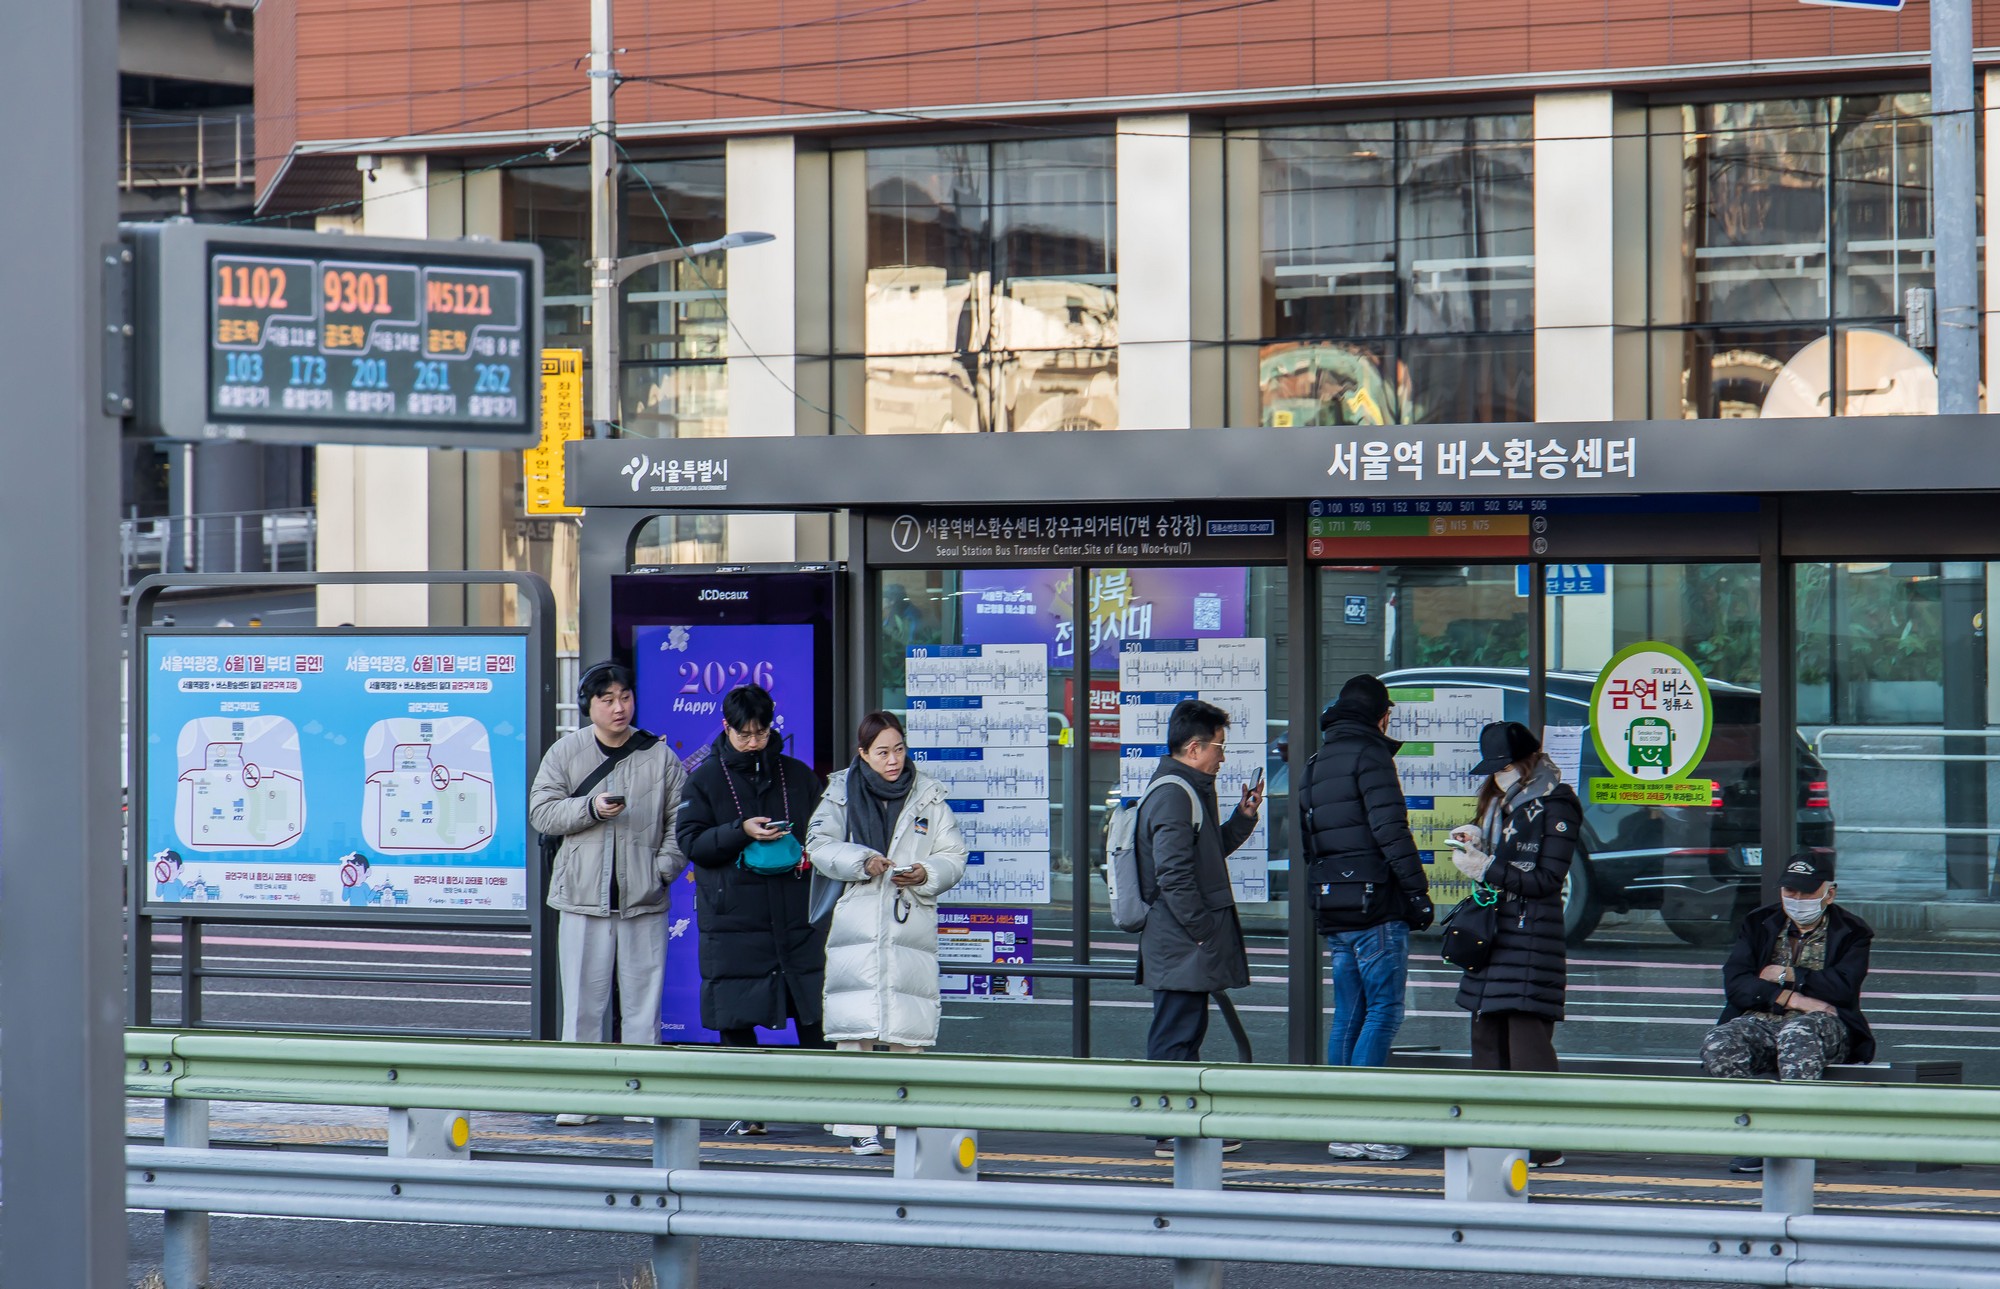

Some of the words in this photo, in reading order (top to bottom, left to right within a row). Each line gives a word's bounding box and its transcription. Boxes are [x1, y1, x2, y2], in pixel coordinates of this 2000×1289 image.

[218, 266, 288, 309] 1102
[324, 270, 392, 314] 9301
[225, 352, 263, 383] 103
[289, 355, 327, 385] 173
[352, 358, 389, 389] 201
[413, 360, 450, 391] 261
[474, 363, 511, 393] 262
[1326, 440, 1423, 481] 서울역
[1437, 437, 1636, 480] 버스환승센터
[650, 459, 728, 483] 서울특별시
[1327, 502, 1342, 513] 100
[1350, 502, 1364, 512] 150
[1372, 502, 1386, 512] 151
[1393, 502, 1408, 512] 152
[1415, 501, 1430, 512] 162
[1437, 501, 1452, 512] 500
[1460, 501, 1475, 511] 501
[1484, 501, 1500, 511] 502
[1507, 500, 1523, 511] 504
[1531, 500, 1547, 510] 506
[1156, 514, 1201, 537] 승강장)
[1328, 521, 1345, 531] 1711
[1353, 520, 1371, 531] 7016
[1451, 520, 1467, 531] N15
[1473, 520, 1489, 530] N75
[936, 546, 959, 556] Seoul
[962, 545, 993, 556] Station
[996, 545, 1011, 555] Bus
[1014, 544, 1050, 555] Transfer
[1104, 543, 1114, 554] of
[1117, 543, 1138, 556] Kang
[1141, 542, 1191, 556] Woo-kyu(7)
[1546, 581, 1593, 593] 단보도
[698, 589, 749, 601] JCDecaux
[912, 648, 928, 660] 100
[1126, 642, 1142, 654] 500
[295, 655, 323, 672] 금연!
[486, 655, 514, 672] 금연!
[679, 661, 775, 695] 2026
[182, 681, 209, 690] 서울역광장
[262, 681, 285, 690] 금연구역
[369, 681, 397, 690] 서울역광장
[452, 681, 475, 690] 금연구역
[1126, 695, 1141, 706] 501
[1608, 678, 1657, 710] 금연
[1663, 678, 1693, 698] 버스
[673, 698, 716, 715] Happy
[912, 700, 927, 712] 150
[1662, 698, 1693, 711] 정류소
[913, 751, 928, 763] 151
[1126, 748, 1142, 760] 502
[1516, 841, 1540, 853] PARIS
[660, 1022, 685, 1030] Decaux
